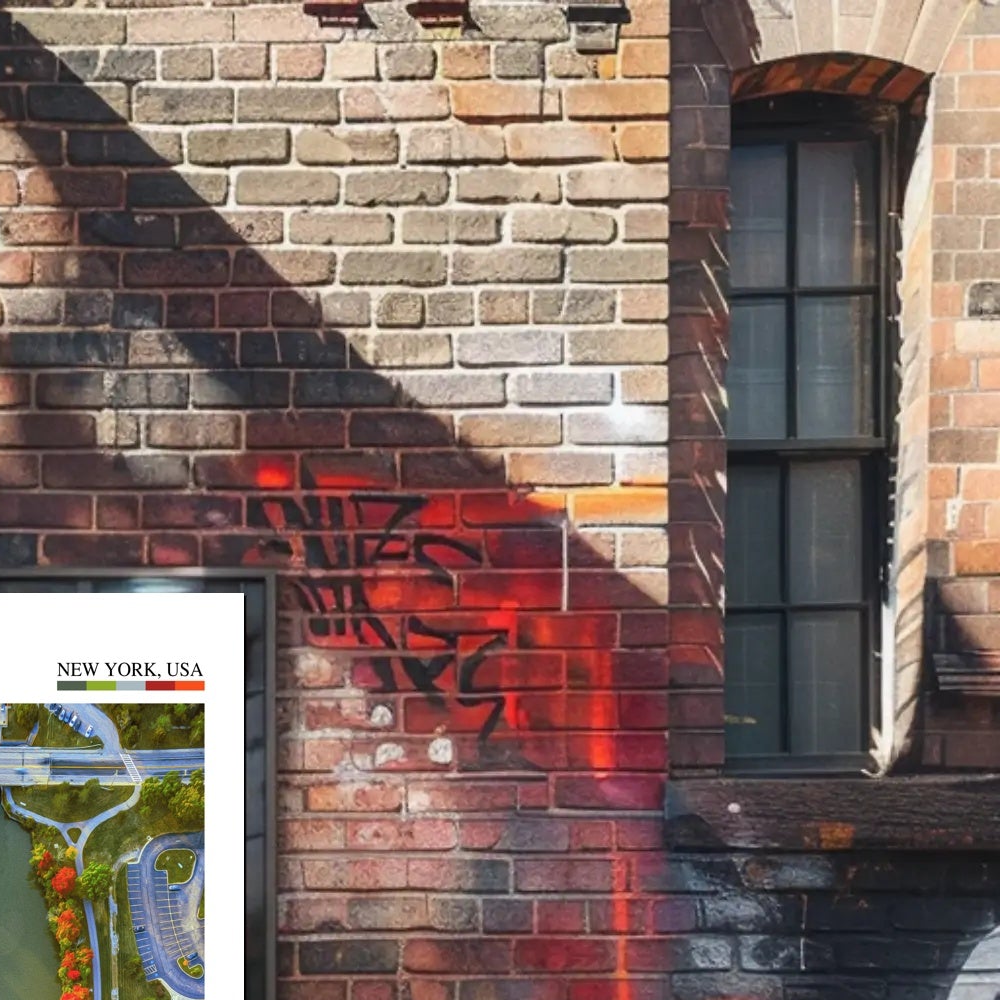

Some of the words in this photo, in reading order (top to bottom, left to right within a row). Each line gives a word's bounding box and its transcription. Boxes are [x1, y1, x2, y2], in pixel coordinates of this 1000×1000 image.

[57, 662, 100, 677] NEW
[104, 661, 162, 680] YORK,
[166, 661, 204, 678] USA
